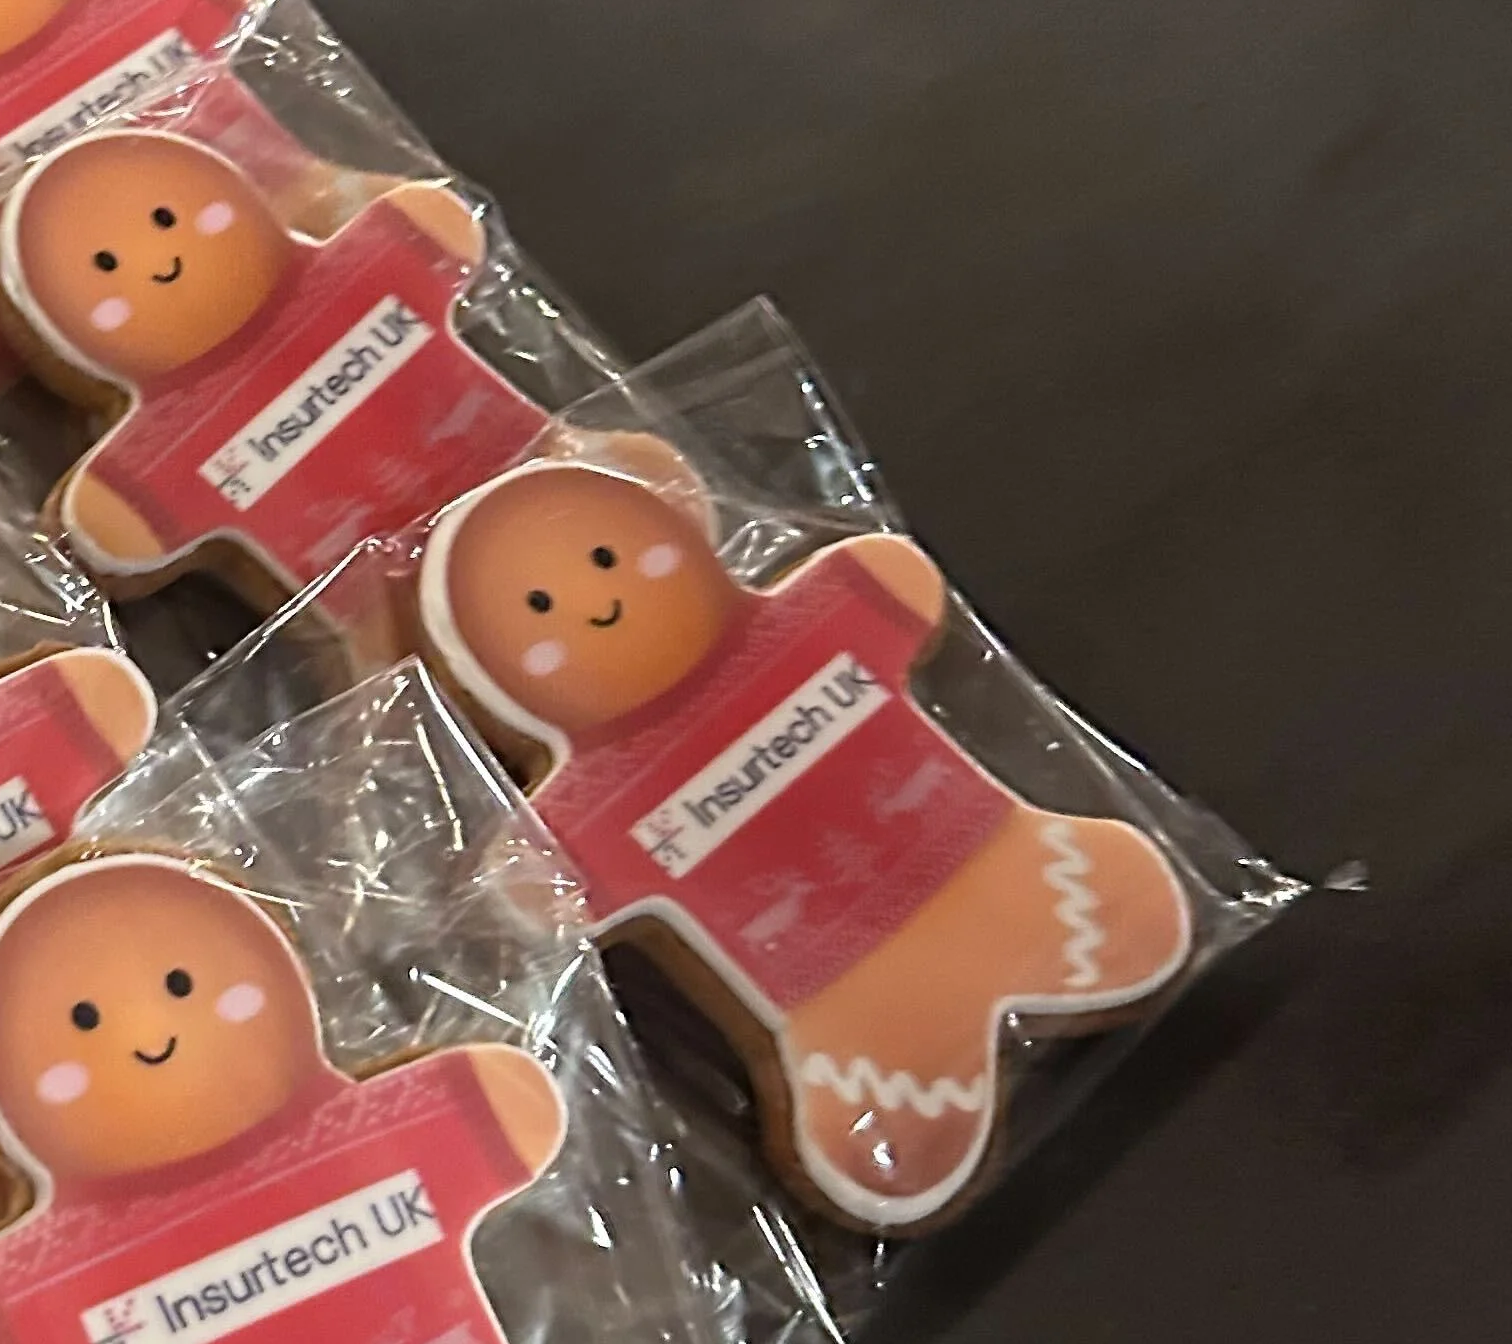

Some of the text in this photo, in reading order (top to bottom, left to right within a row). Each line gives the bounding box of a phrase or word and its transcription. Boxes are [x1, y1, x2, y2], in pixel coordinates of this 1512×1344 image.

[247, 303, 422, 462] Insurtech UK
[681, 662, 877, 828] Insurtech UK
[156, 1182, 437, 1334] Insurtech UK
